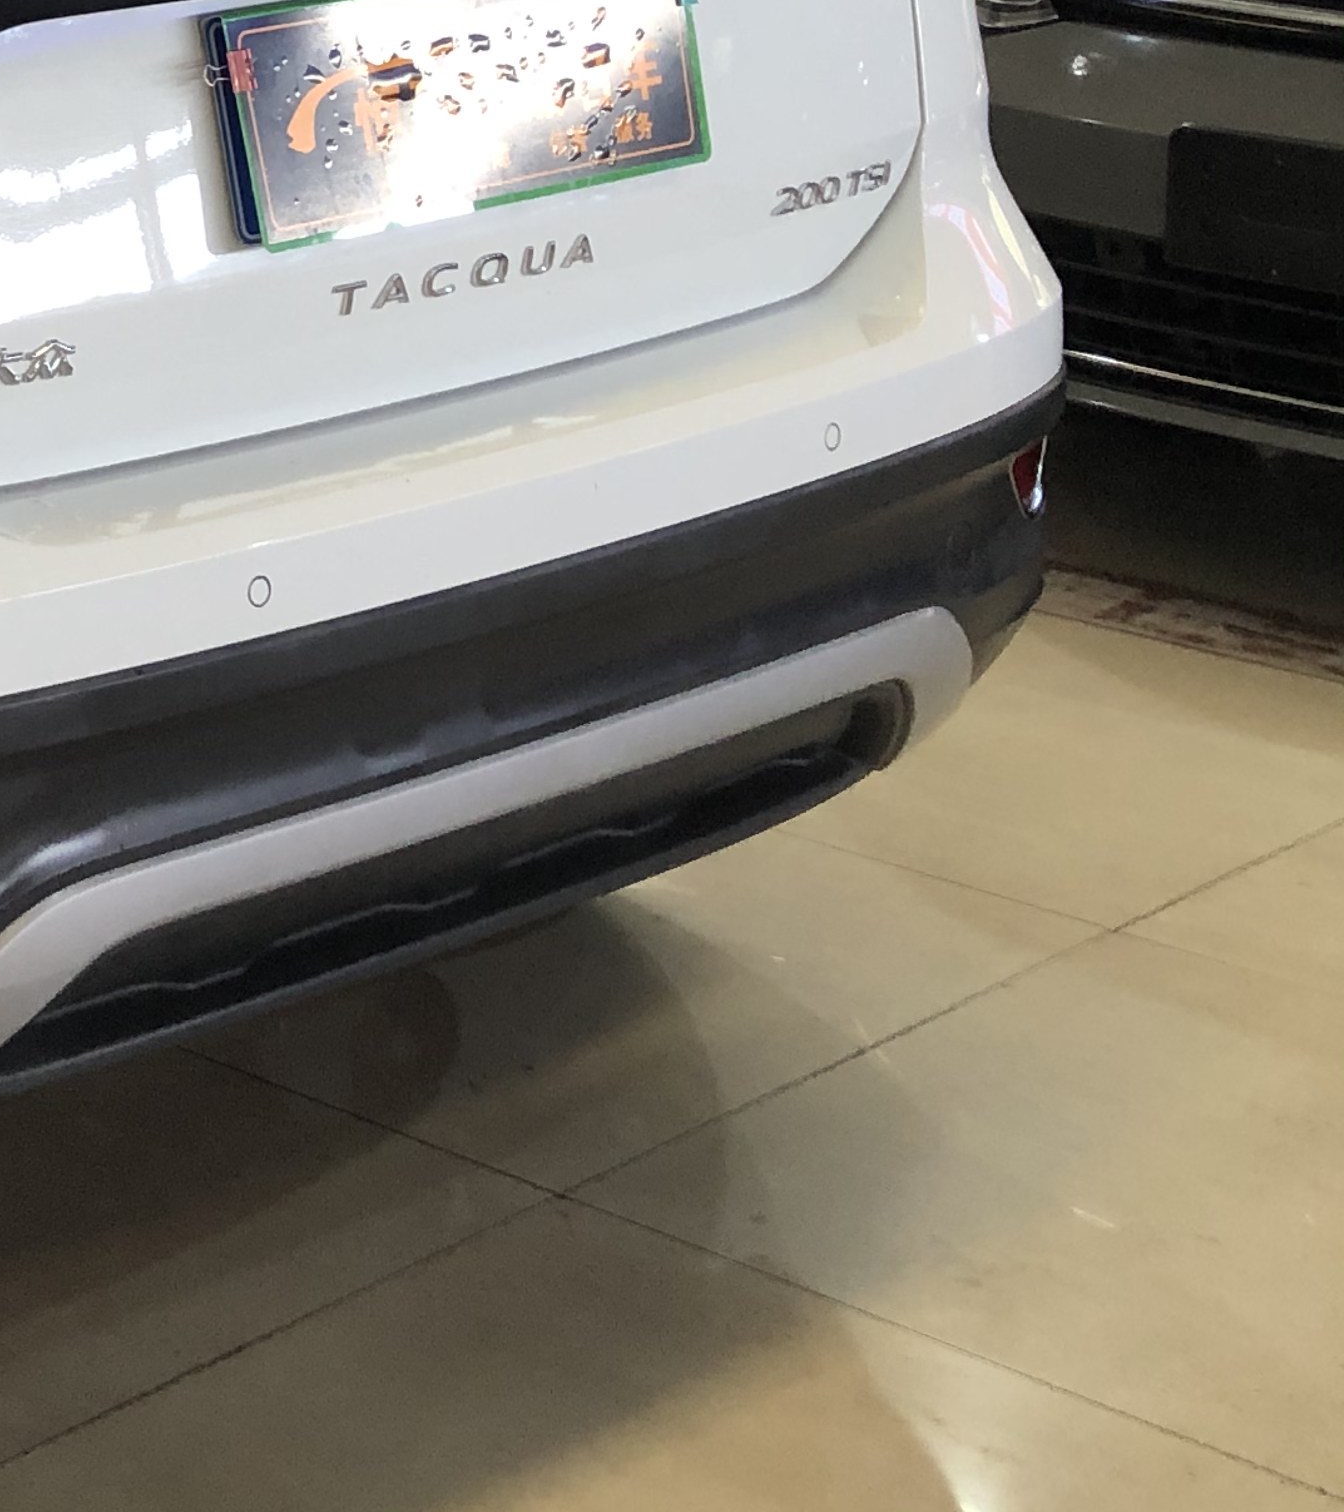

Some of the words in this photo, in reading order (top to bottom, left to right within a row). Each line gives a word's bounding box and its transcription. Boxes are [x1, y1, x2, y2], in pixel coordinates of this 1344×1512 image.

[770, 175, 842, 217] 200
[846, 158, 892, 197] TSI
[331, 233, 597, 317] TACQUA
